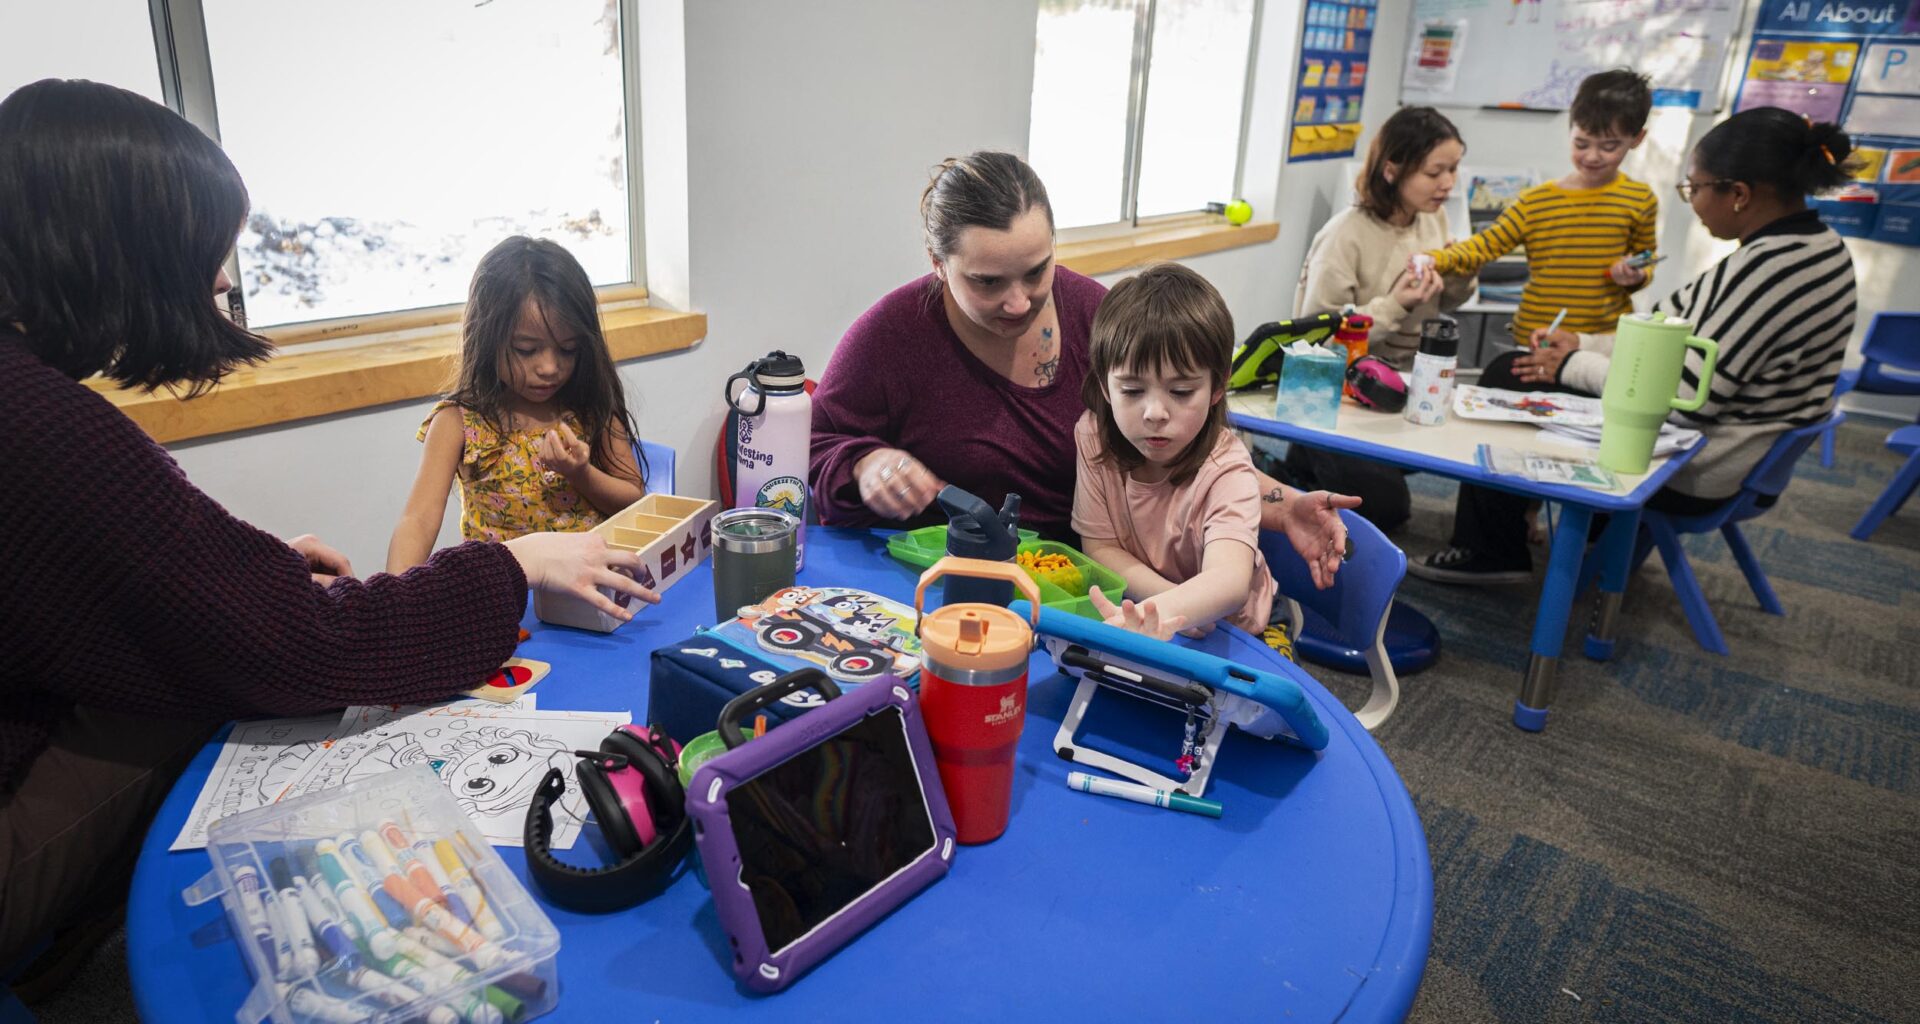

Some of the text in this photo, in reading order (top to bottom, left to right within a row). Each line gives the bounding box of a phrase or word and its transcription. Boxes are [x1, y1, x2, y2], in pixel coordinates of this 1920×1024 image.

[1778, 1, 1896, 24] All About
[1880, 48, 1908, 80] P
[763, 479, 789, 493] SQUEEZE
[235, 754, 269, 775] for
